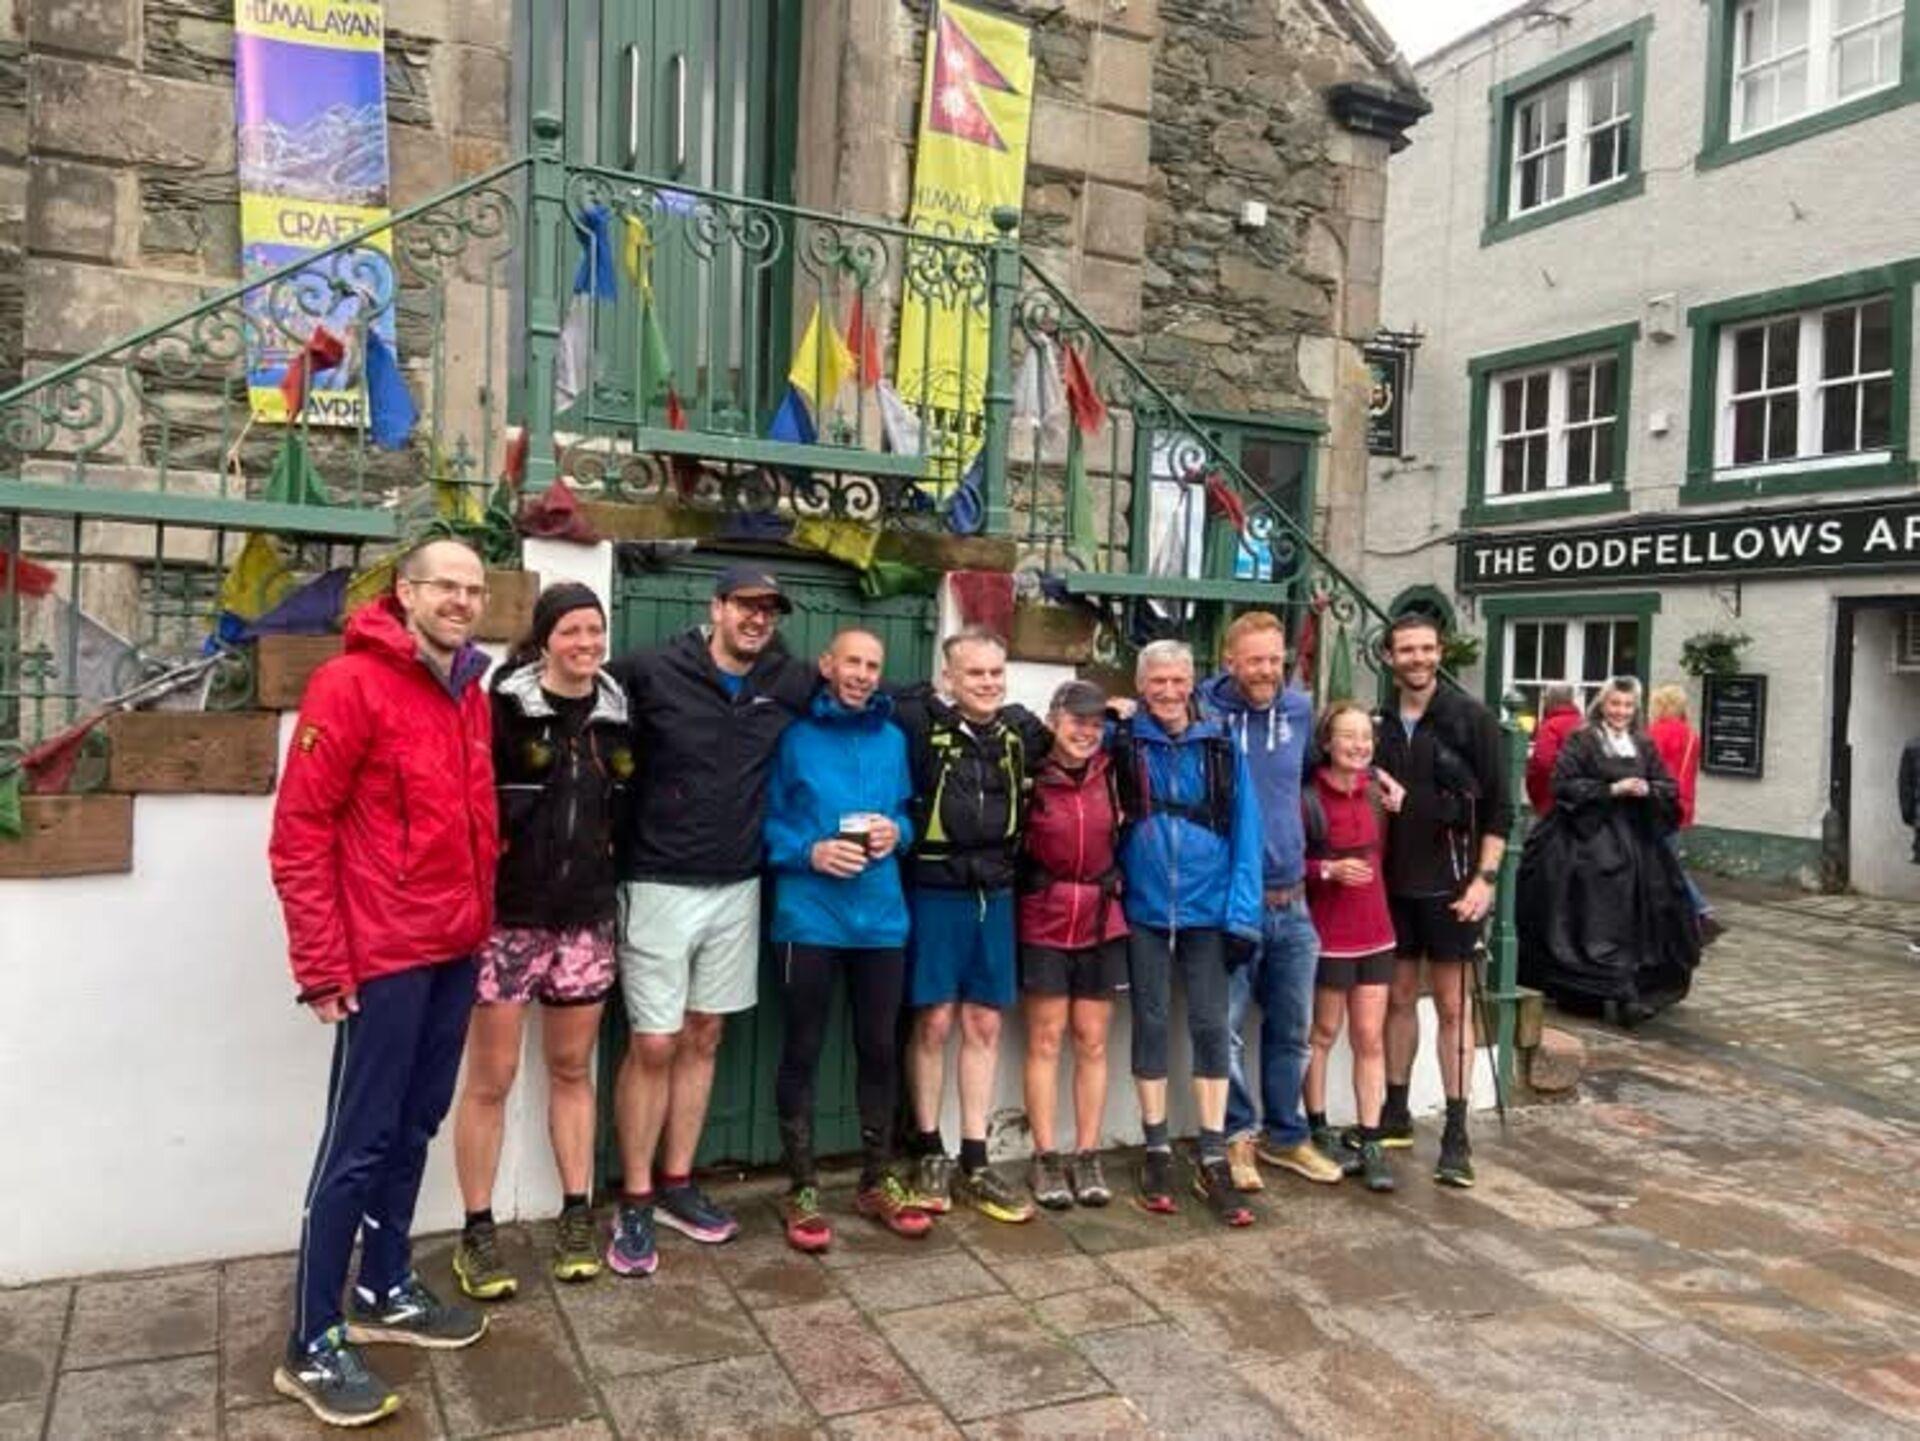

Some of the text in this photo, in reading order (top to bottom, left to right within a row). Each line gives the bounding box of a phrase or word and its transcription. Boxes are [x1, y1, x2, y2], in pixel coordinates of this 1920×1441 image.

[245, 0, 381, 37] HIMALAYAN
[917, 183, 991, 219] HIMALA
[1474, 546, 1537, 575] THE
[1548, 520, 1843, 572] ODDFELLOWS
